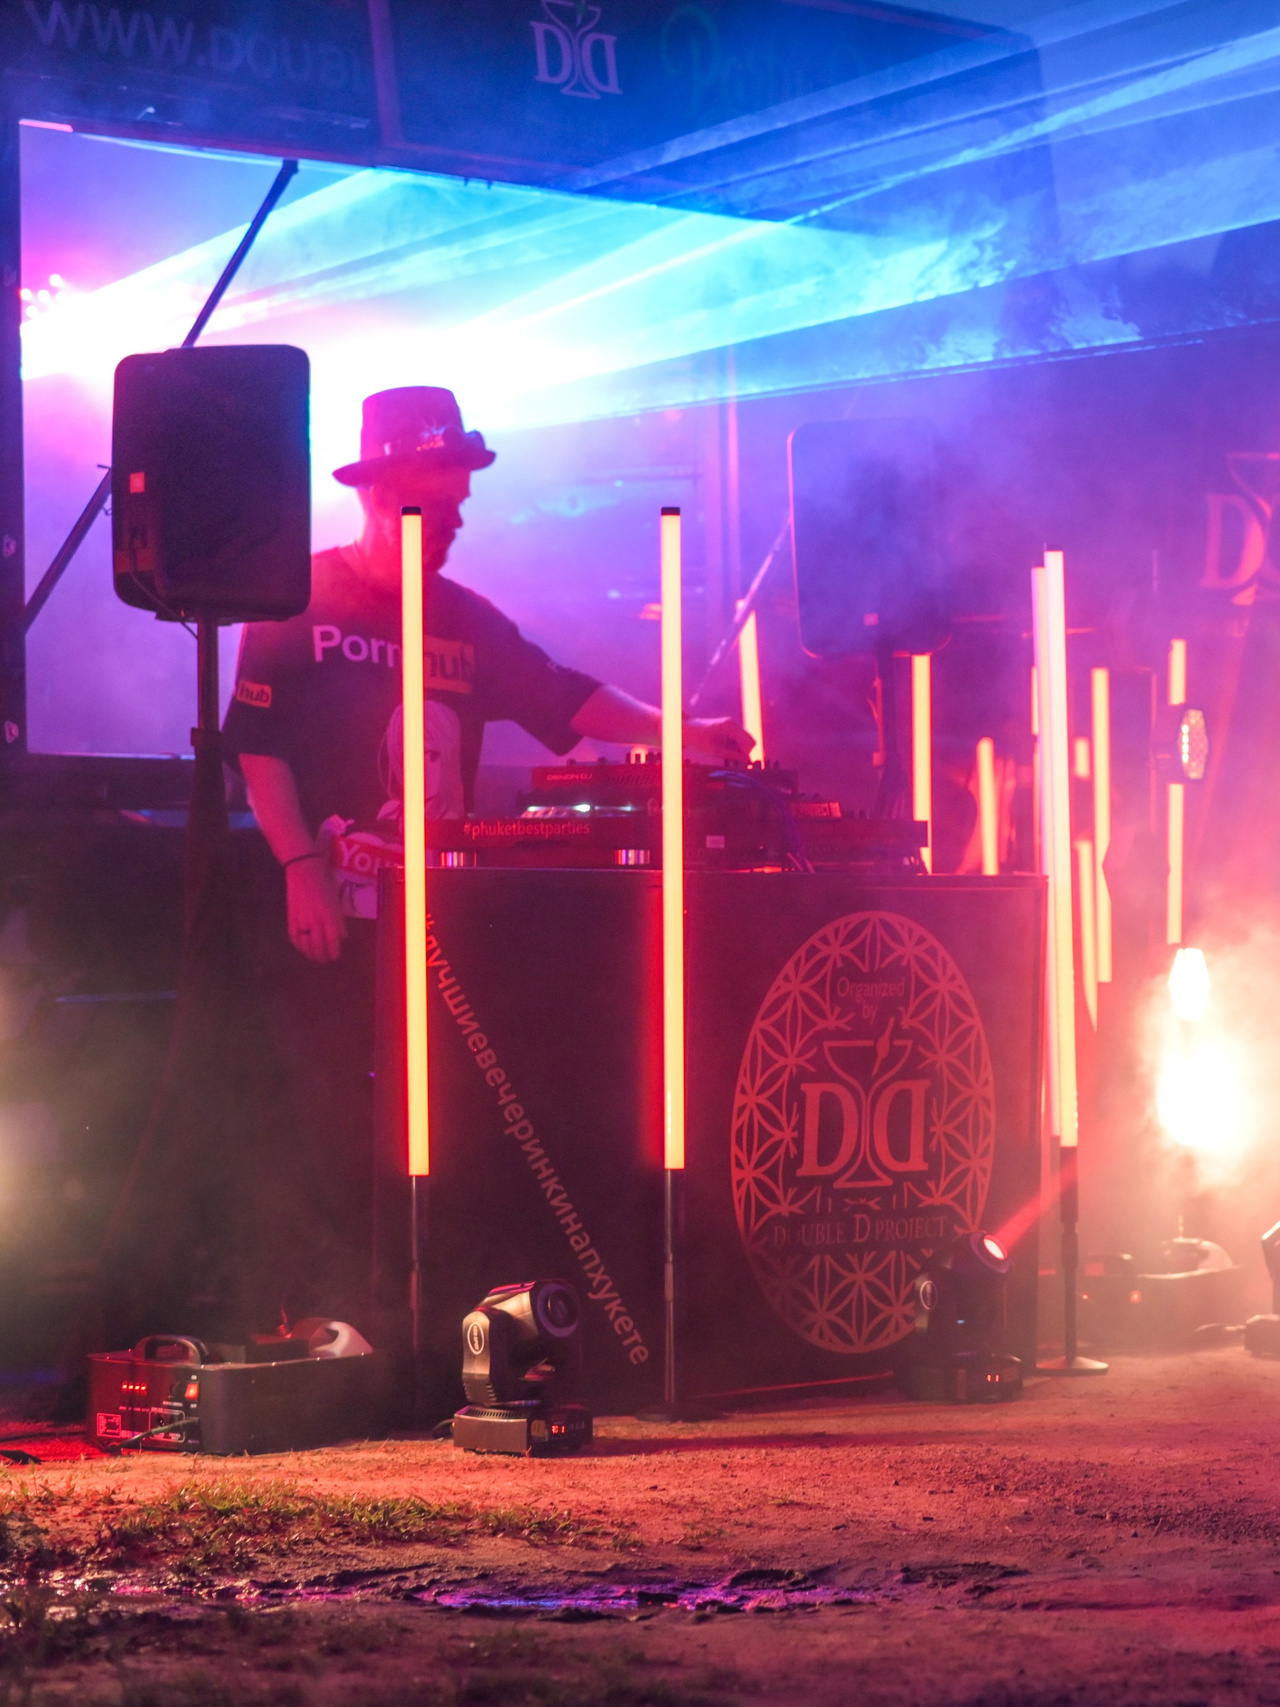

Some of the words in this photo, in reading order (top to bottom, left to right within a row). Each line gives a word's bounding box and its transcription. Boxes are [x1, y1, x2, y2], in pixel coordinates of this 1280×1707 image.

[463, 820, 590, 840] #phuketbestparties
[836, 976, 905, 1003] Organized
[862, 1003, 878, 1026] by
[773, 1220, 846, 1248] DUBLE
[852, 1213, 872, 1243] D
[875, 1216, 949, 1243] PROJECT
